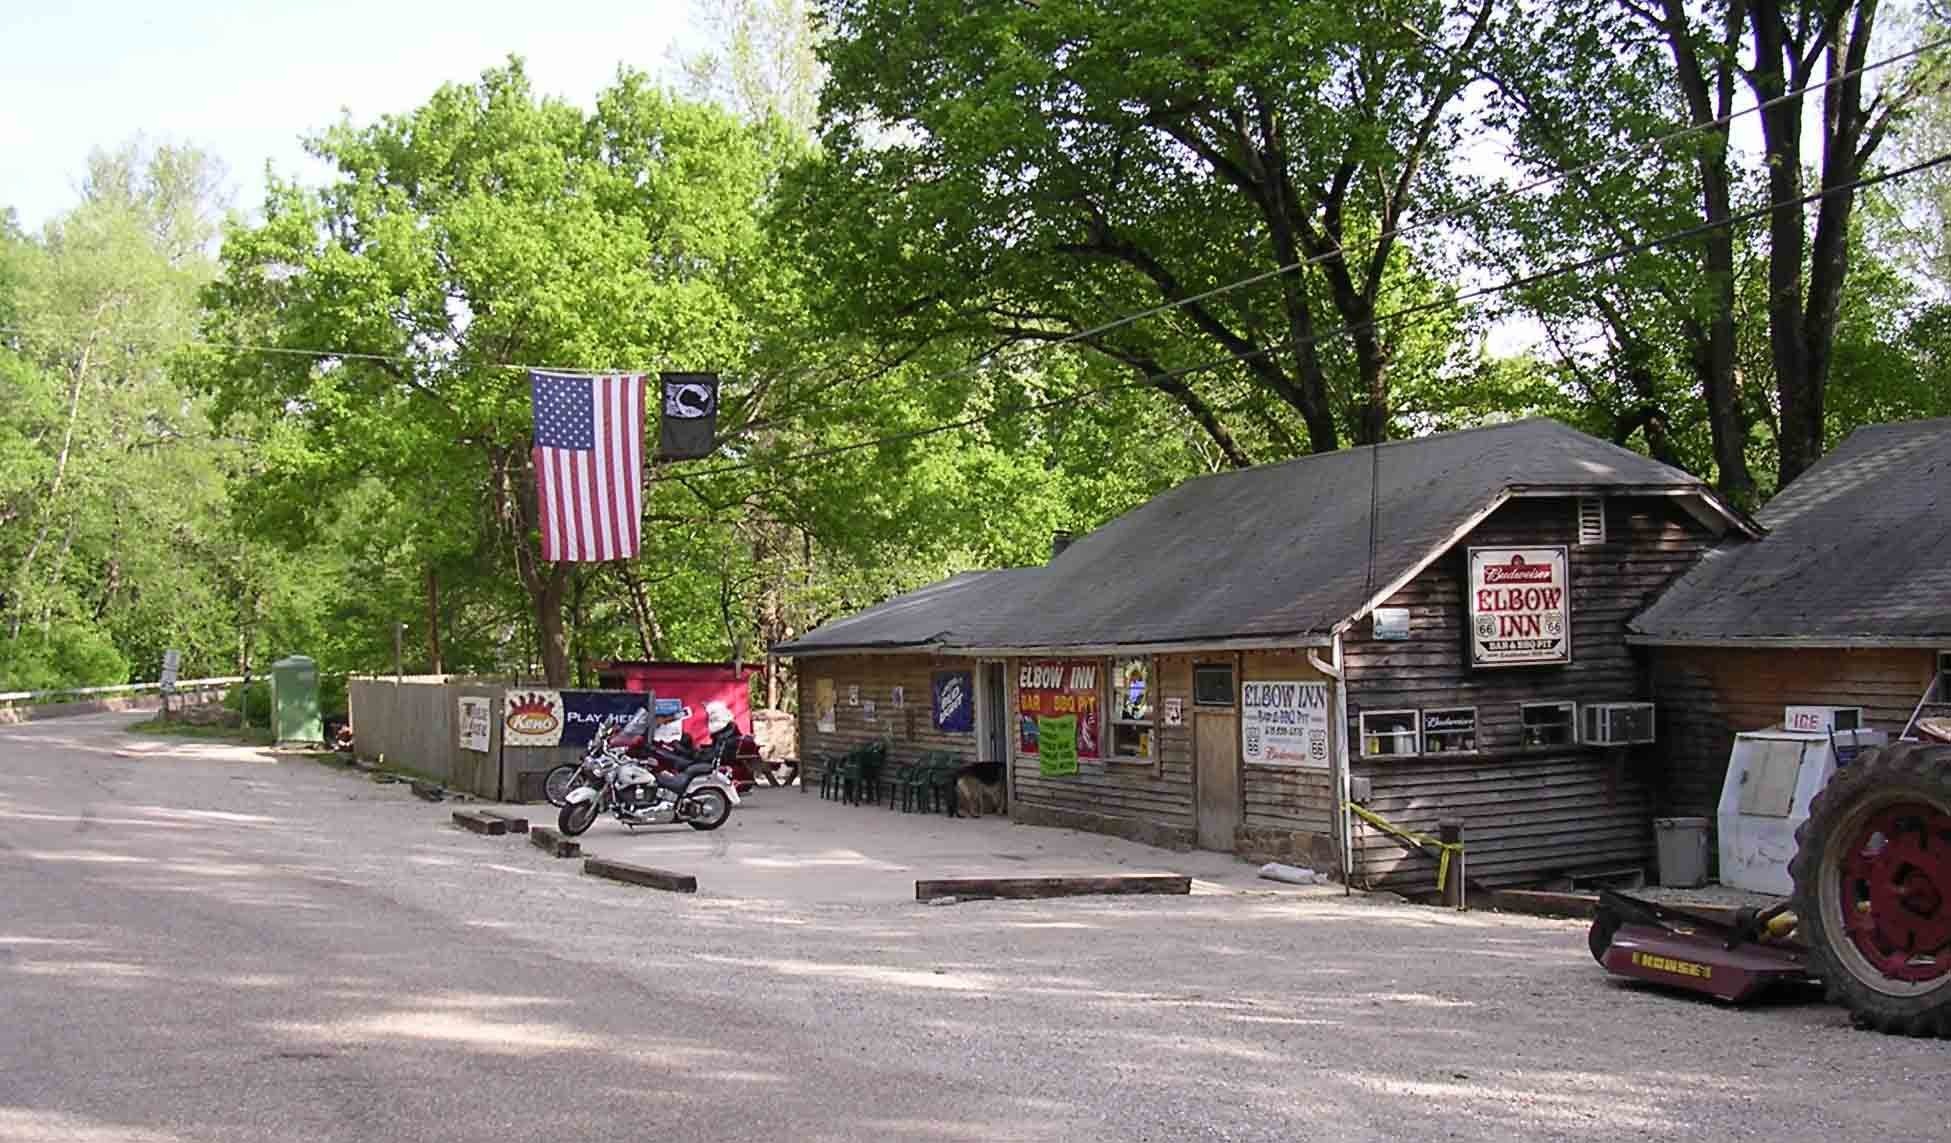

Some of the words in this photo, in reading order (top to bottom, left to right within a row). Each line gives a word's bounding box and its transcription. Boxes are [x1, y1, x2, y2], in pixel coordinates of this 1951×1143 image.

[1486, 567, 1551, 581] Budweiser
[1477, 588, 1562, 612] ELBOW
[1498, 615, 1541, 638] INN
[1537, 639, 1552, 649] PIT
[1020, 665, 1063, 688] ELBOW
[1071, 666, 1095, 688] INN
[1244, 684, 1295, 708] ELBOW
[1298, 685, 1325, 709] INN
[1794, 713, 1819, 729] ICE
